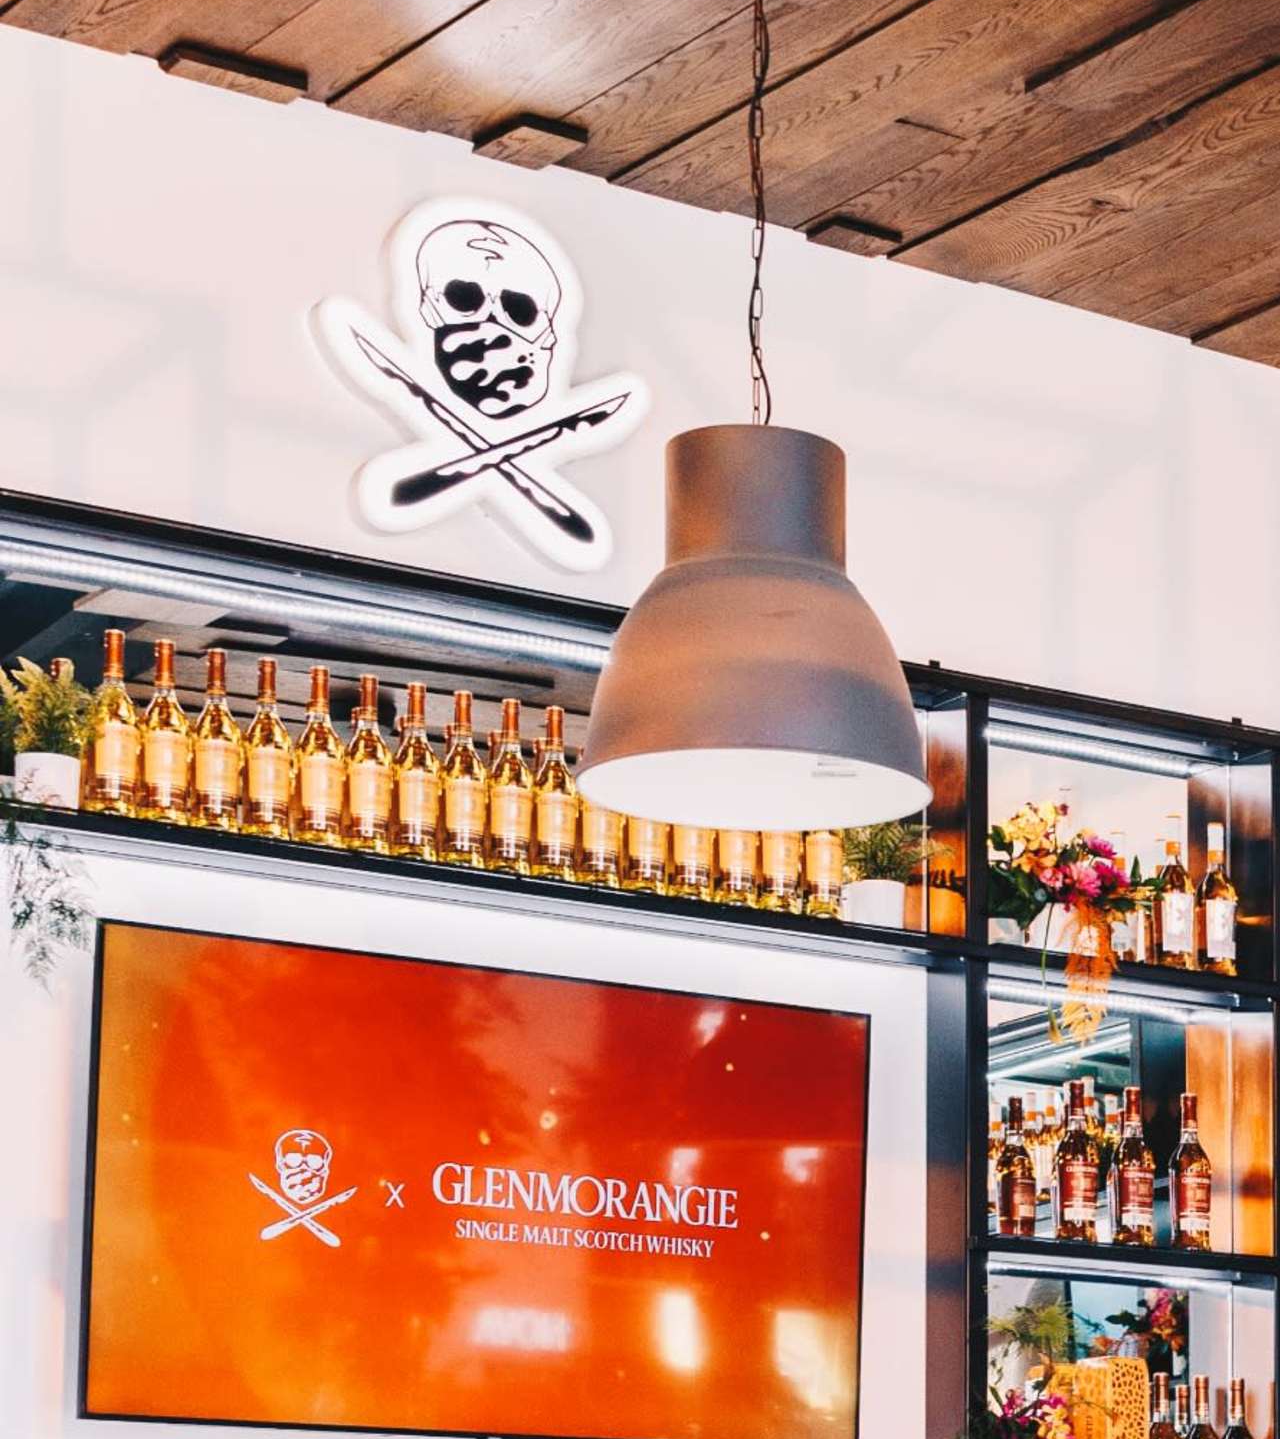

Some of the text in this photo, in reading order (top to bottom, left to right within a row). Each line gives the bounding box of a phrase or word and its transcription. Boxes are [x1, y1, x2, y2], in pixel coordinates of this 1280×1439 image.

[431, 1161, 740, 1229] GLENMORANGIE
[455, 1217, 716, 1259] SINGLE MALT SCOTCH WHISKY
